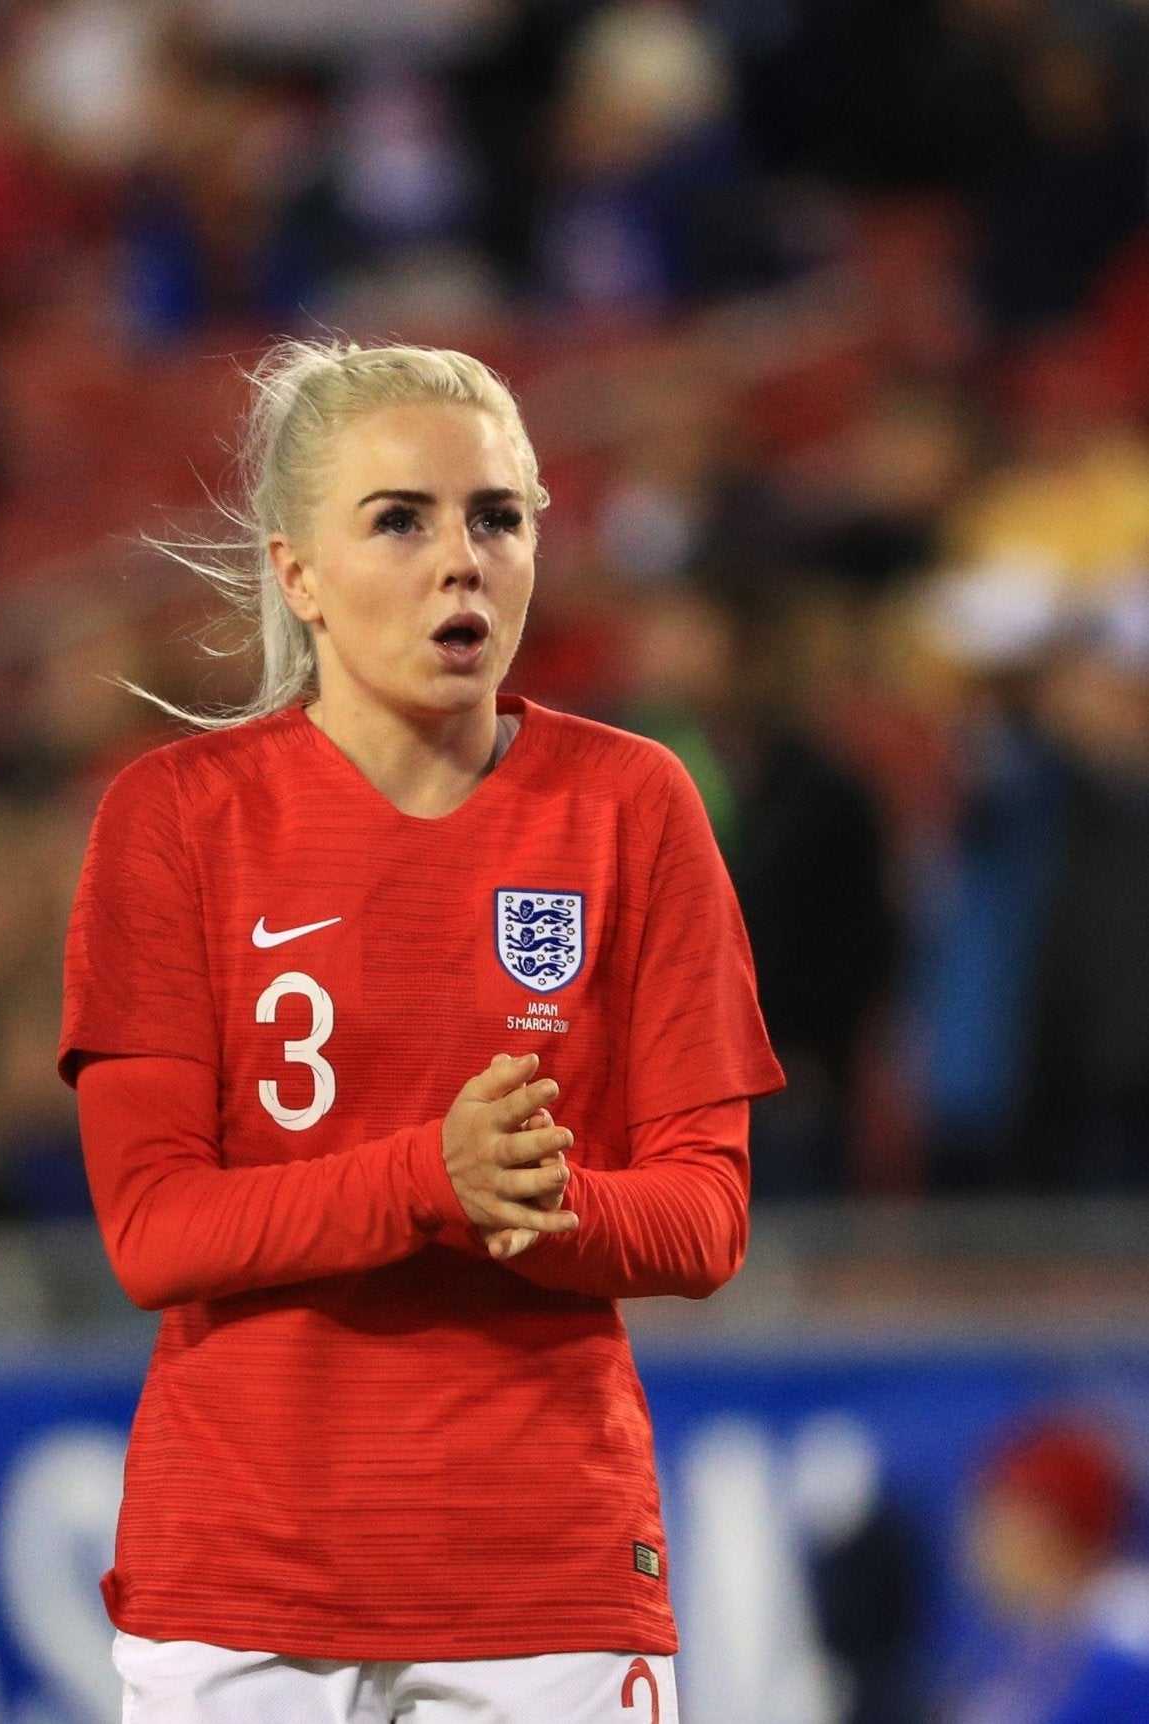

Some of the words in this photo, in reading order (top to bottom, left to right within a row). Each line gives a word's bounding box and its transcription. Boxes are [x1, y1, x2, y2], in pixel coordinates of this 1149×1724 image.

[526, 1002, 558, 1016] JAPAN
[507, 1015, 515, 1029] 5
[515, 1017, 551, 1031] MARCH
[255, 971, 336, 1131] 3
